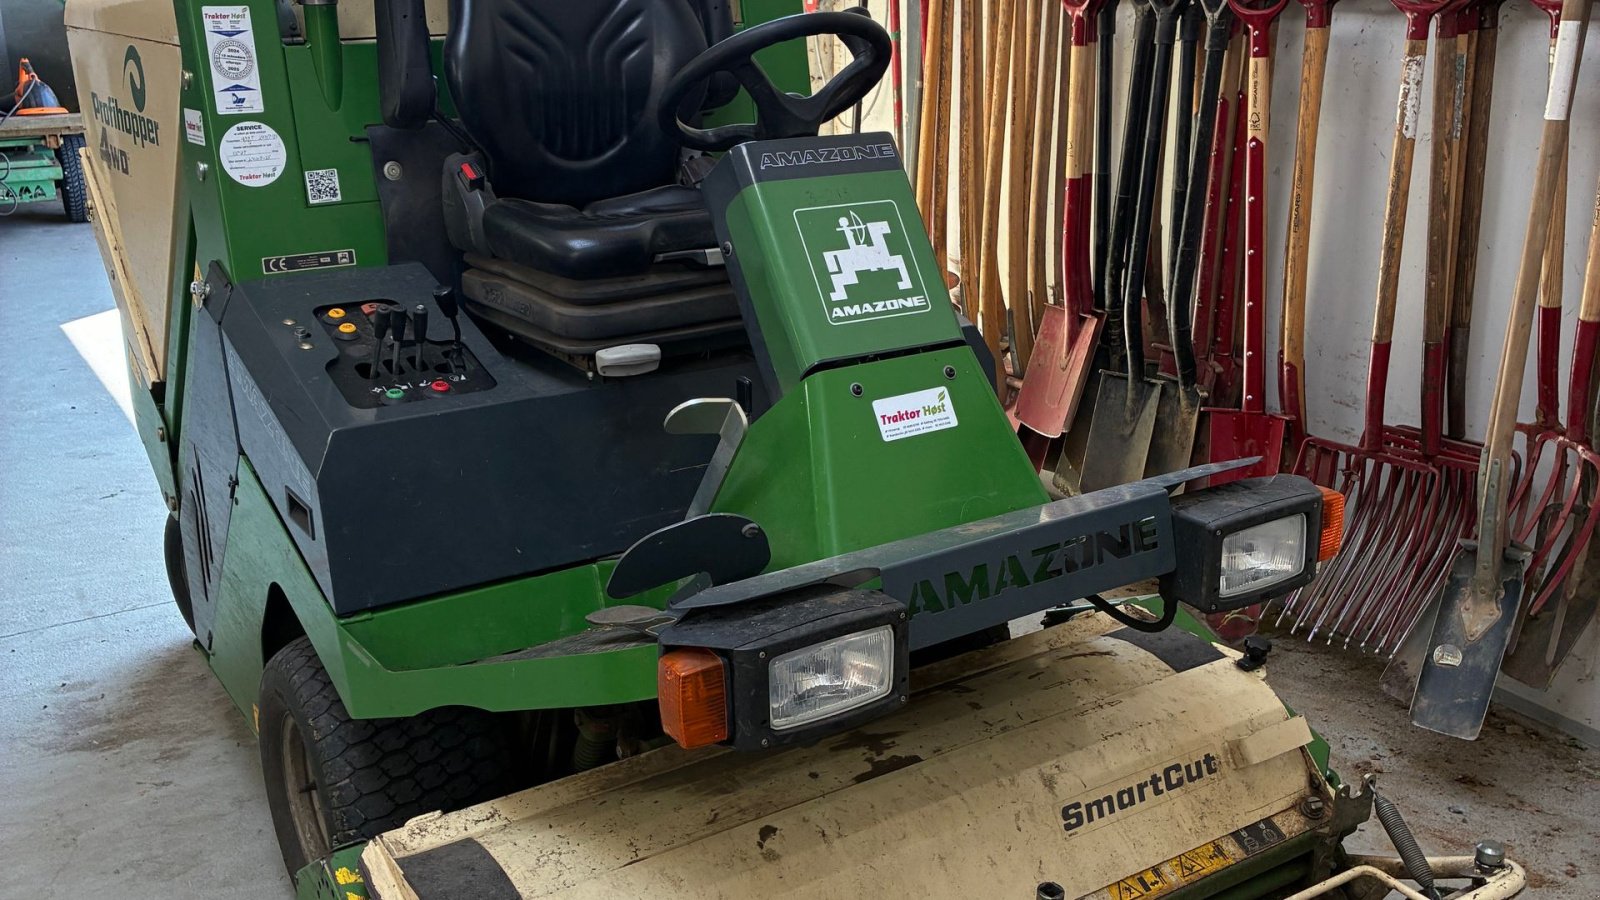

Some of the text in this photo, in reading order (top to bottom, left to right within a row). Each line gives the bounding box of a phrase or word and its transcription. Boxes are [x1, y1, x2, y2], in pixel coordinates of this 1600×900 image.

[91, 91, 160, 149] Profihopper
[236, 124, 263, 132] SERVICE
[760, 142, 896, 170] AMAZONE
[239, 173, 262, 181] Traktor
[831, 295, 927, 319] AMAZONE
[880, 409, 921, 426] Traktor
[922, 402, 946, 417] Høst
[908, 515, 1159, 610] AMAZONE
[1061, 752, 1218, 832] SmartCut
